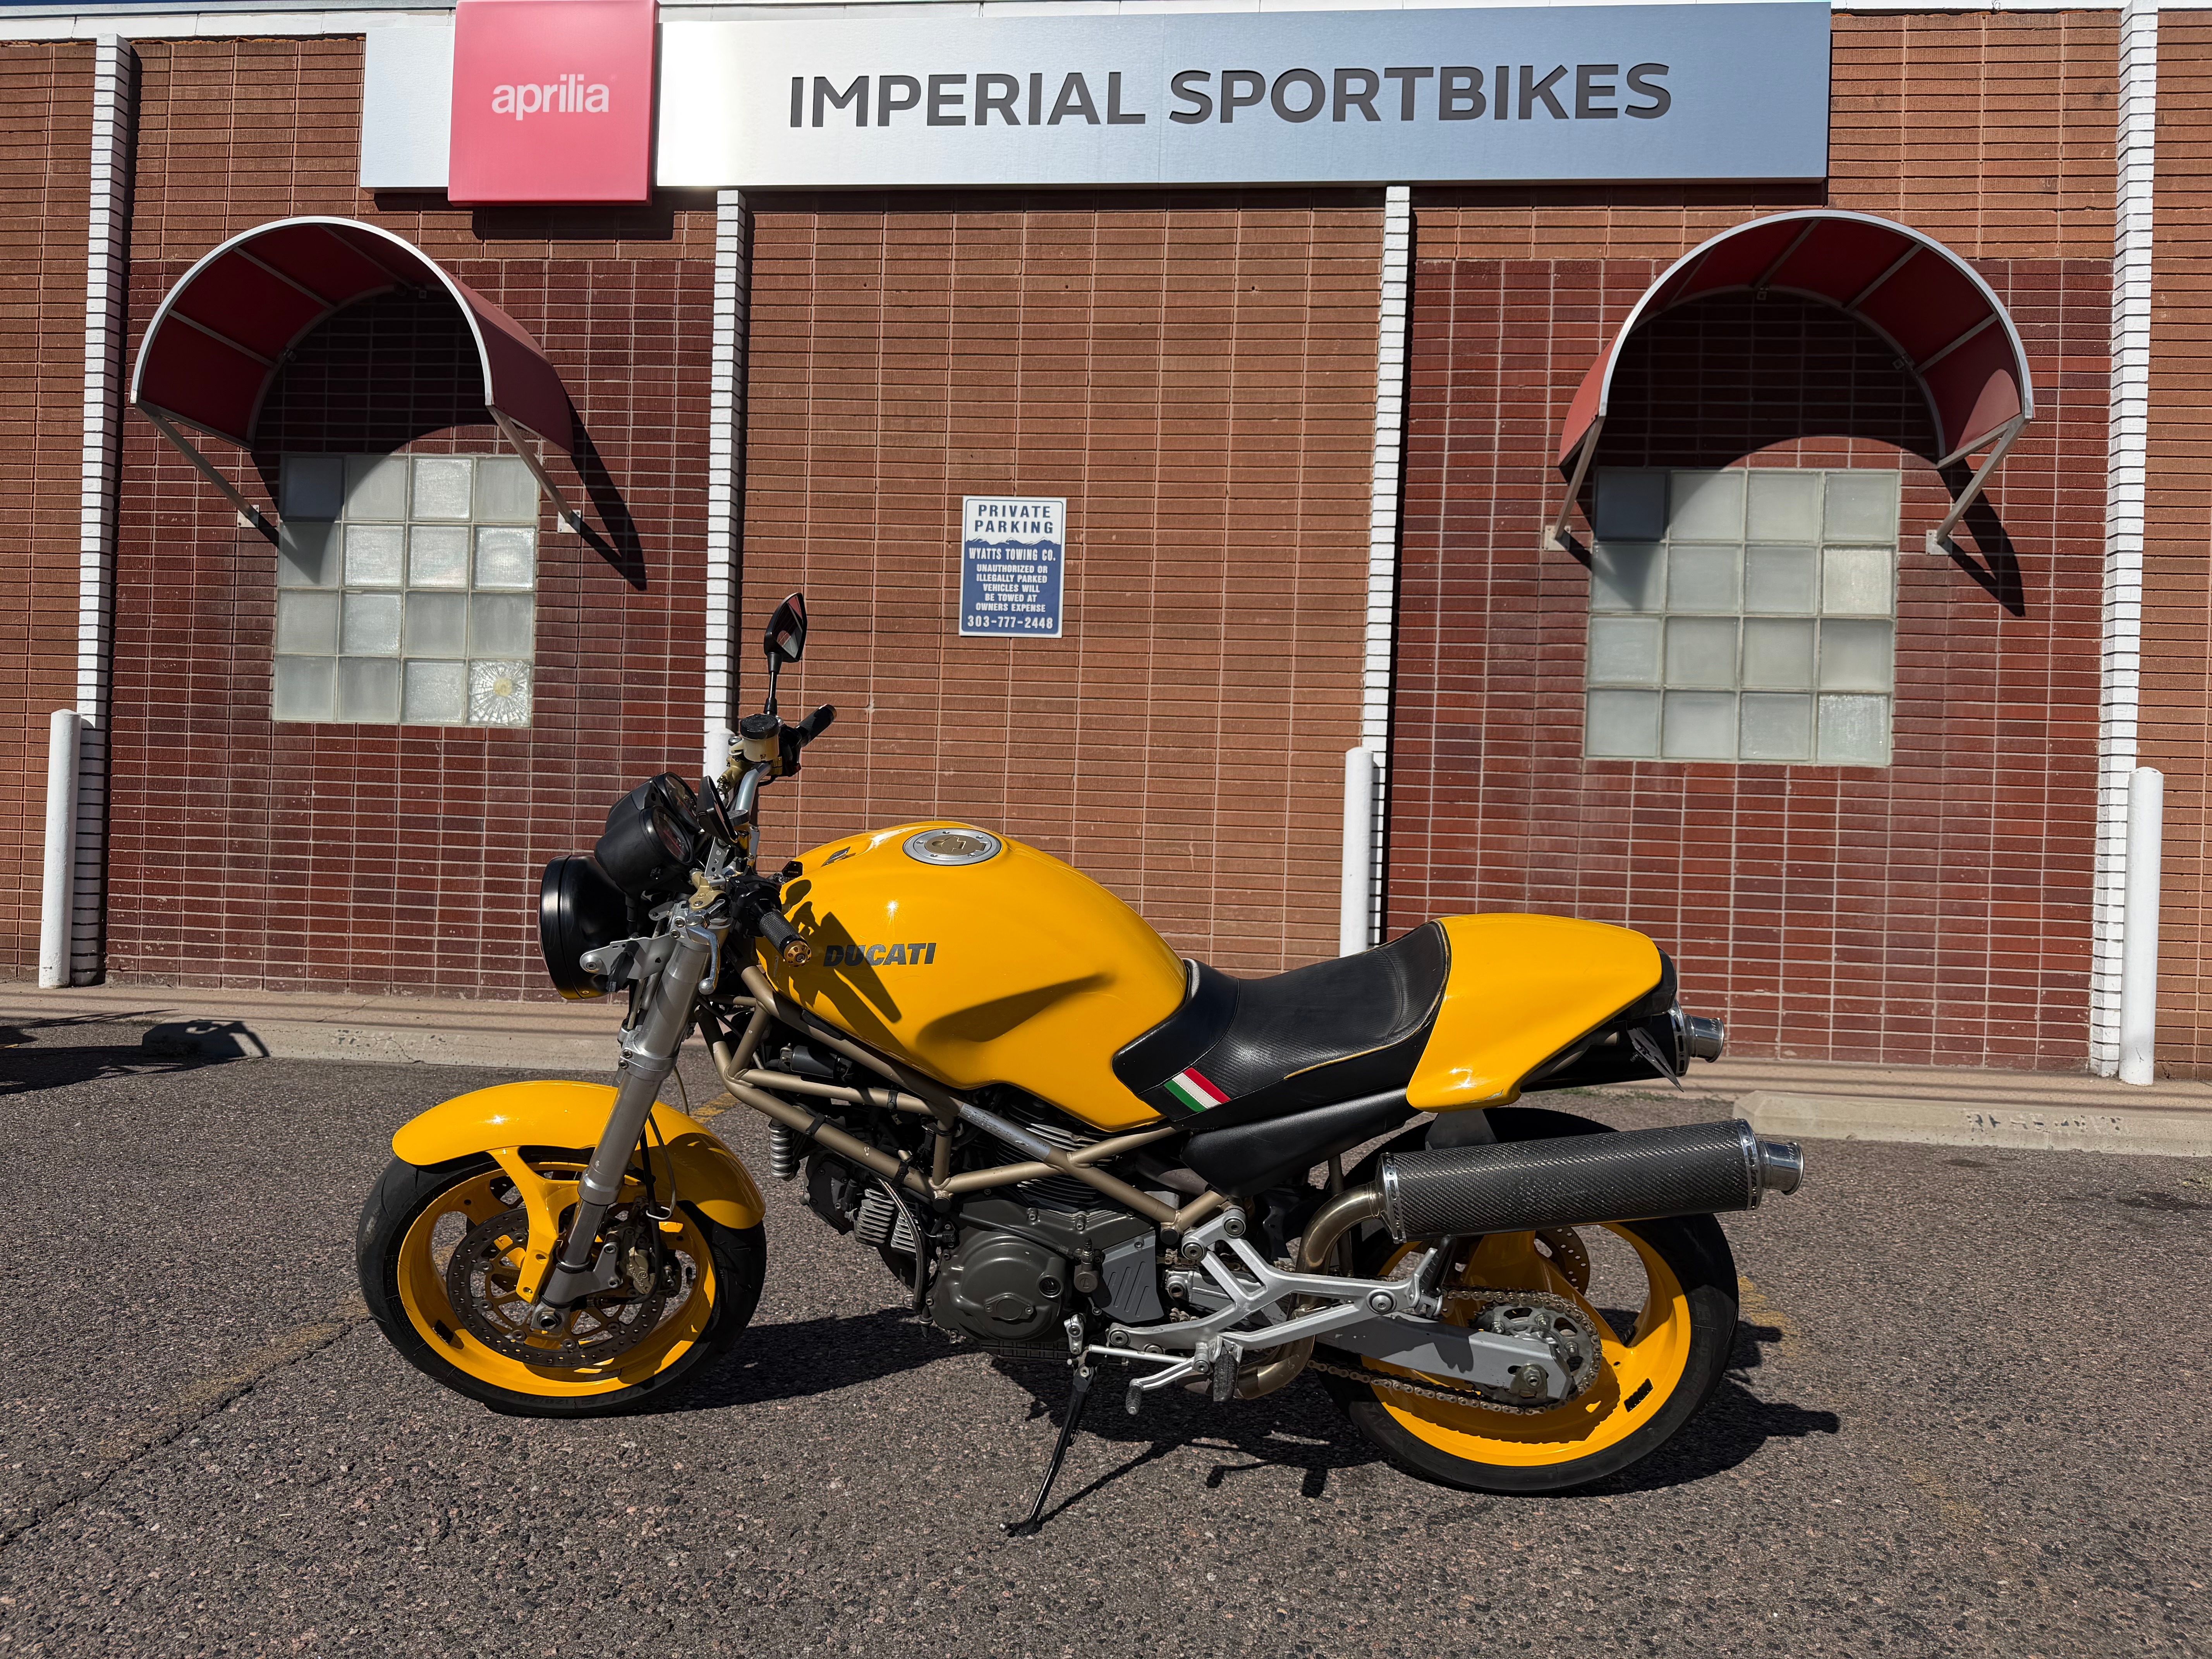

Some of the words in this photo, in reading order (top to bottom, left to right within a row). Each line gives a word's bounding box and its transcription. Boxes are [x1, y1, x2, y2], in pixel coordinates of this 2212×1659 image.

[491, 74, 609, 121] aprilia
[790, 71, 1146, 128] IMPERIAL
[1168, 62, 1672, 125] SPORTBIKES
[978, 505, 1051, 518] PRIVATE
[975, 520, 1053, 534] PARKING
[969, 548, 1002, 560] WYATTS
[1005, 548, 1038, 561] TOWING
[1042, 549, 1056, 561] CO.
[977, 564, 1034, 573] UNAUTHORIZED
[1037, 565, 1048, 574] OR
[976, 574, 1015, 582] ILLEGALLY
[1017, 575, 1048, 583] PARKED
[983, 584, 1019, 592] VEHICLES
[1022, 585, 1040, 593] WILL
[985, 593, 994, 601] BE
[998, 594, 1024, 602] TOWED
[975, 603, 1008, 611] OWNERS
[1011, 604, 1046, 612] EXPENSE
[968, 615, 1053, 629] 303-777-2448
[823, 942, 937, 967] DUCATI
